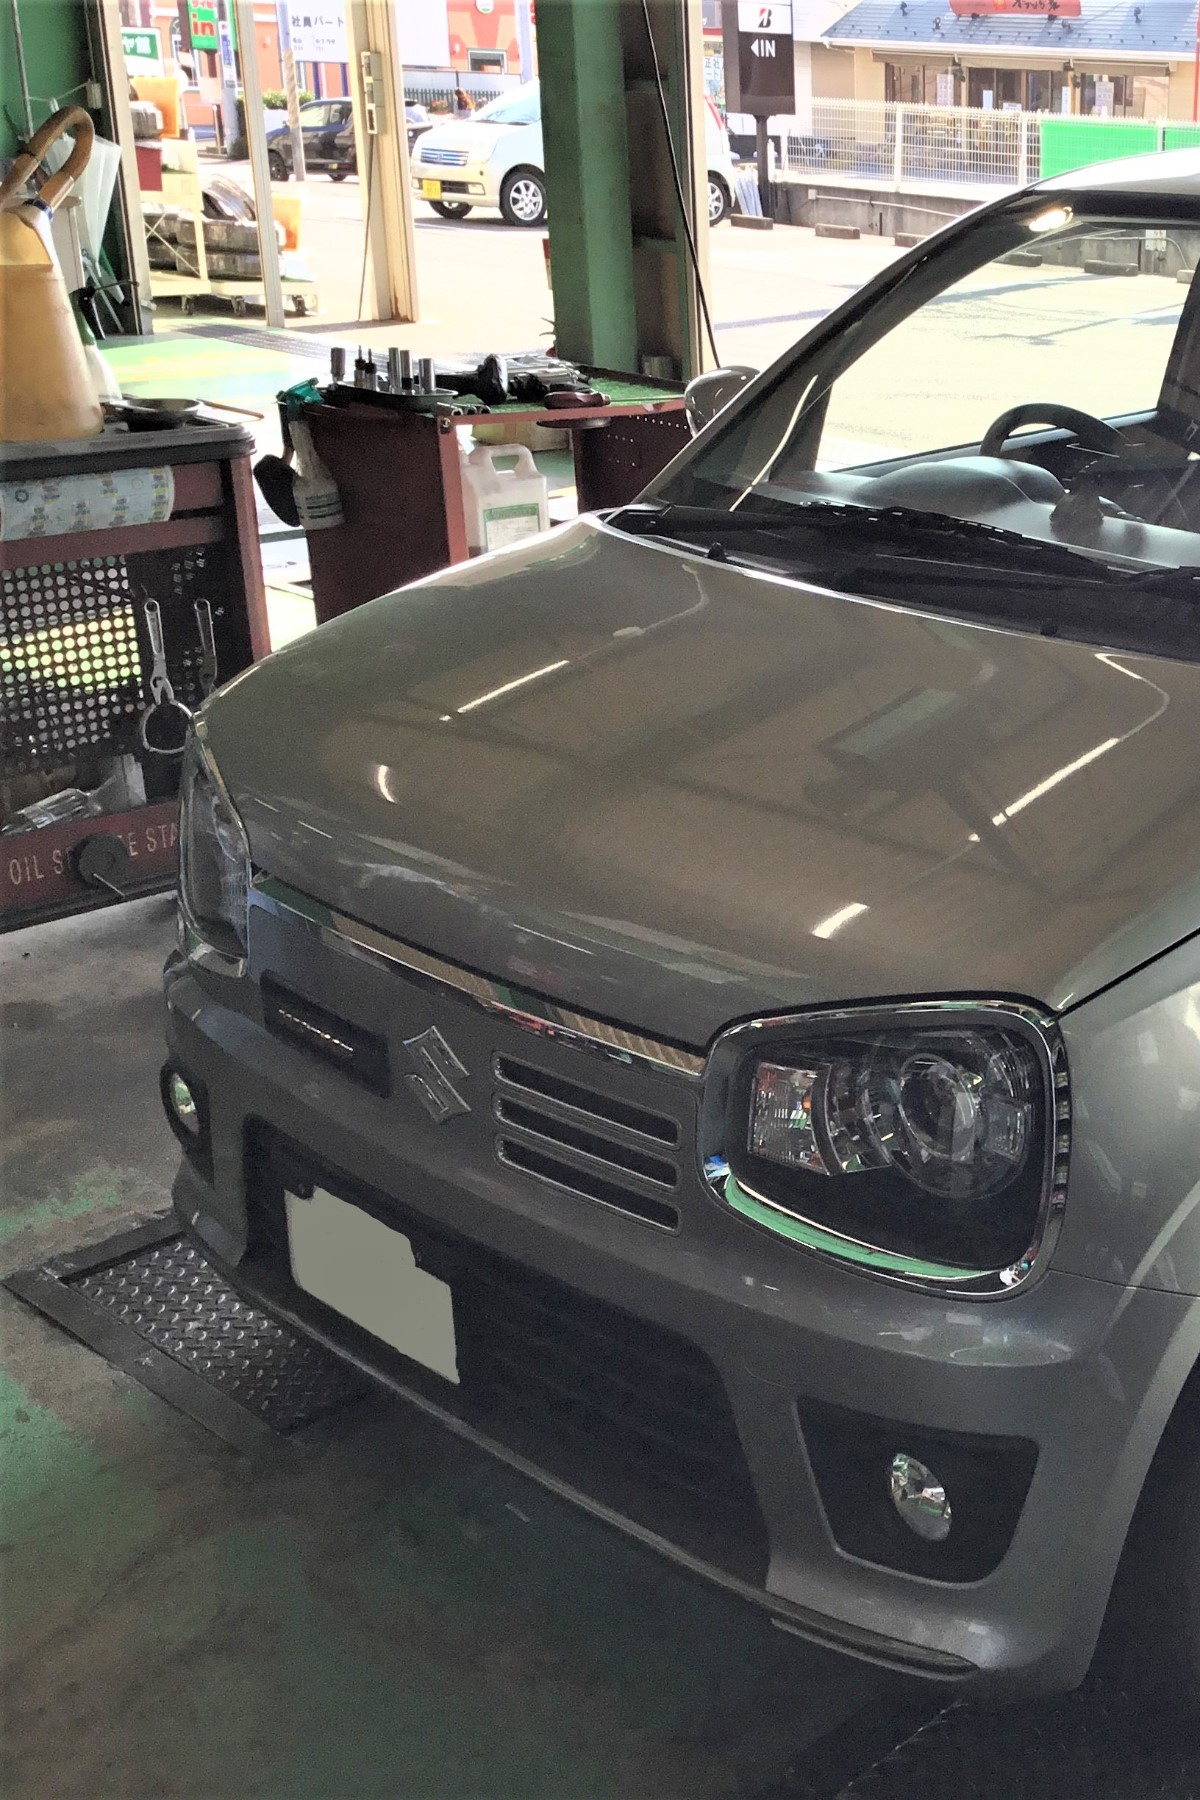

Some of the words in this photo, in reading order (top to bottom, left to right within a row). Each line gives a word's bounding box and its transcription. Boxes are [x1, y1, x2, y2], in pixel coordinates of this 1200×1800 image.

[192, 13, 215, 36] in
[760, 39, 776, 57] IN
[9, 855, 45, 885] OIL
